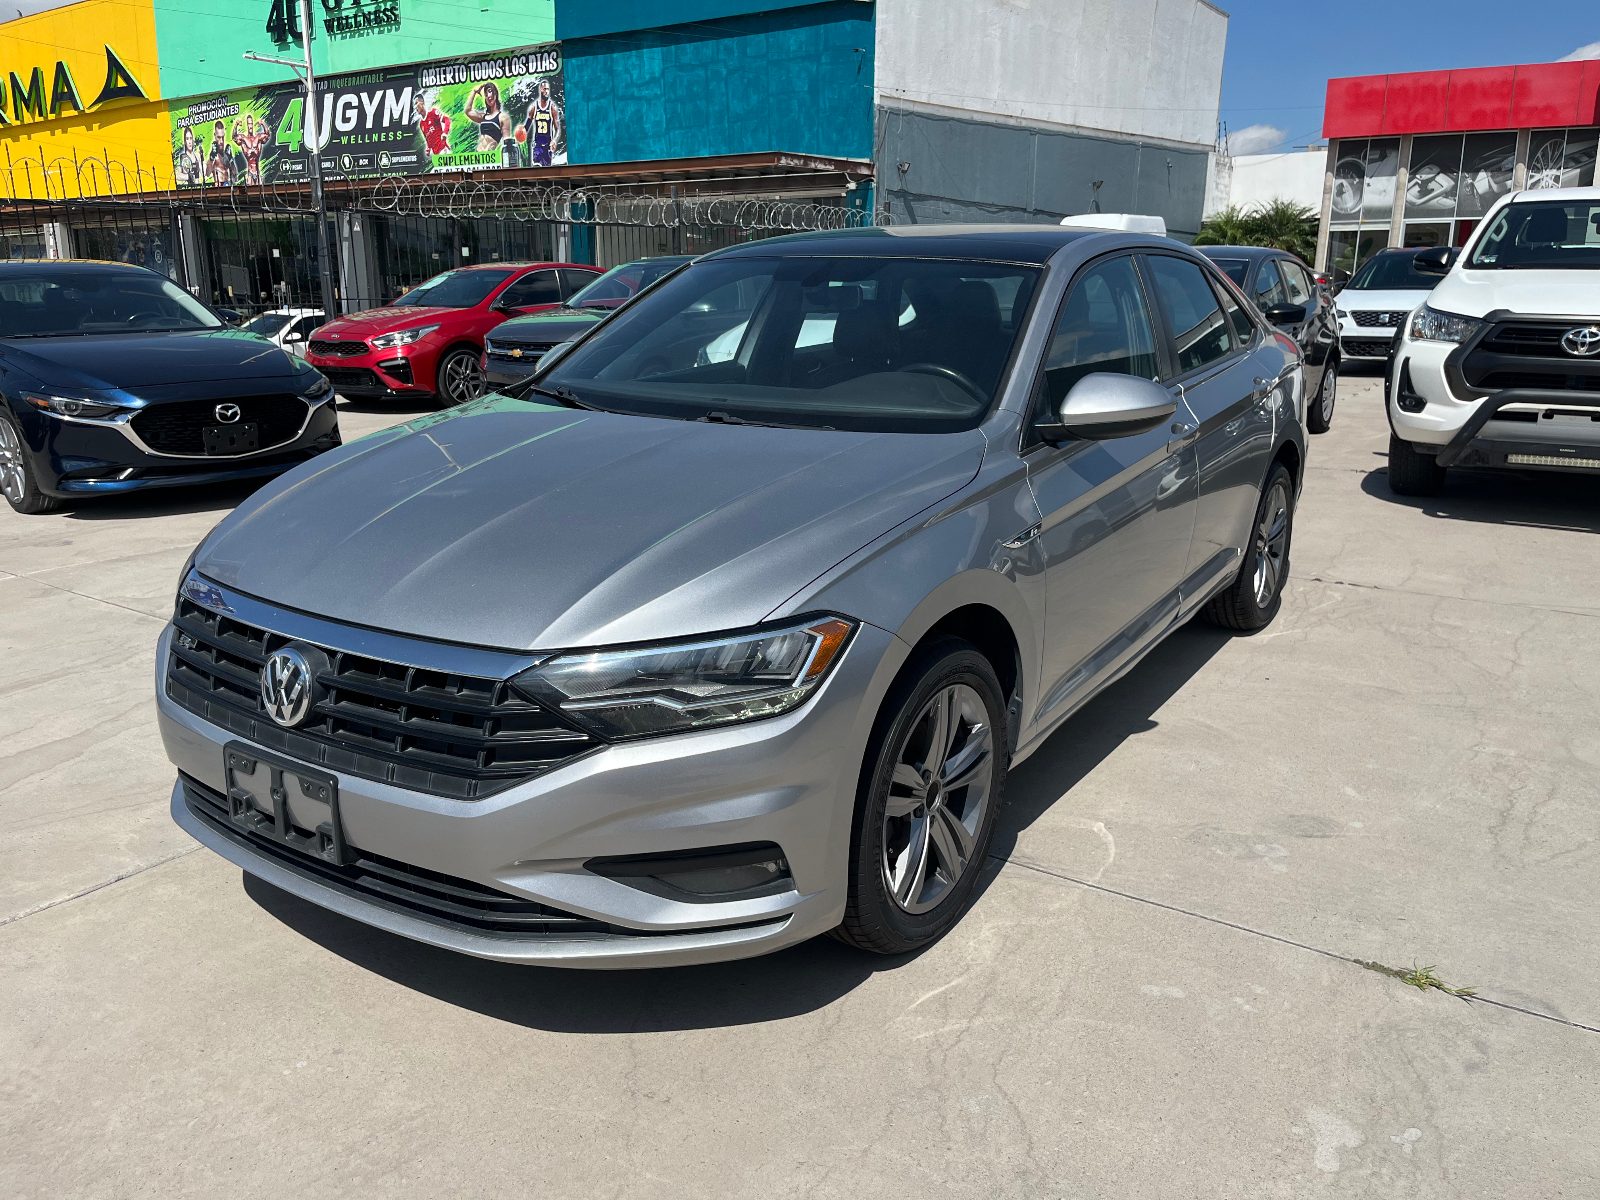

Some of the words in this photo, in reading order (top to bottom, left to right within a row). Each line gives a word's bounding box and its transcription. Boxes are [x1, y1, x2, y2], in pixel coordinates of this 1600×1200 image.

[422, 64, 467, 87] ABIERTO
[468, 59, 503, 81] TODOS
[505, 57, 526, 77] LOS
[528, 51, 558, 73] DIAS
[298, 80, 328, 93] VOTAD
[329, 73, 384, 89] INQUEBRANTABLE
[177, 115, 194, 128] PARA
[194, 105, 239, 124] ESTUDIANTES
[340, 131, 403, 145] WELLNESS
[438, 153, 496, 167] SUPLEMENTOS
[261, 647, 312, 727] VW
